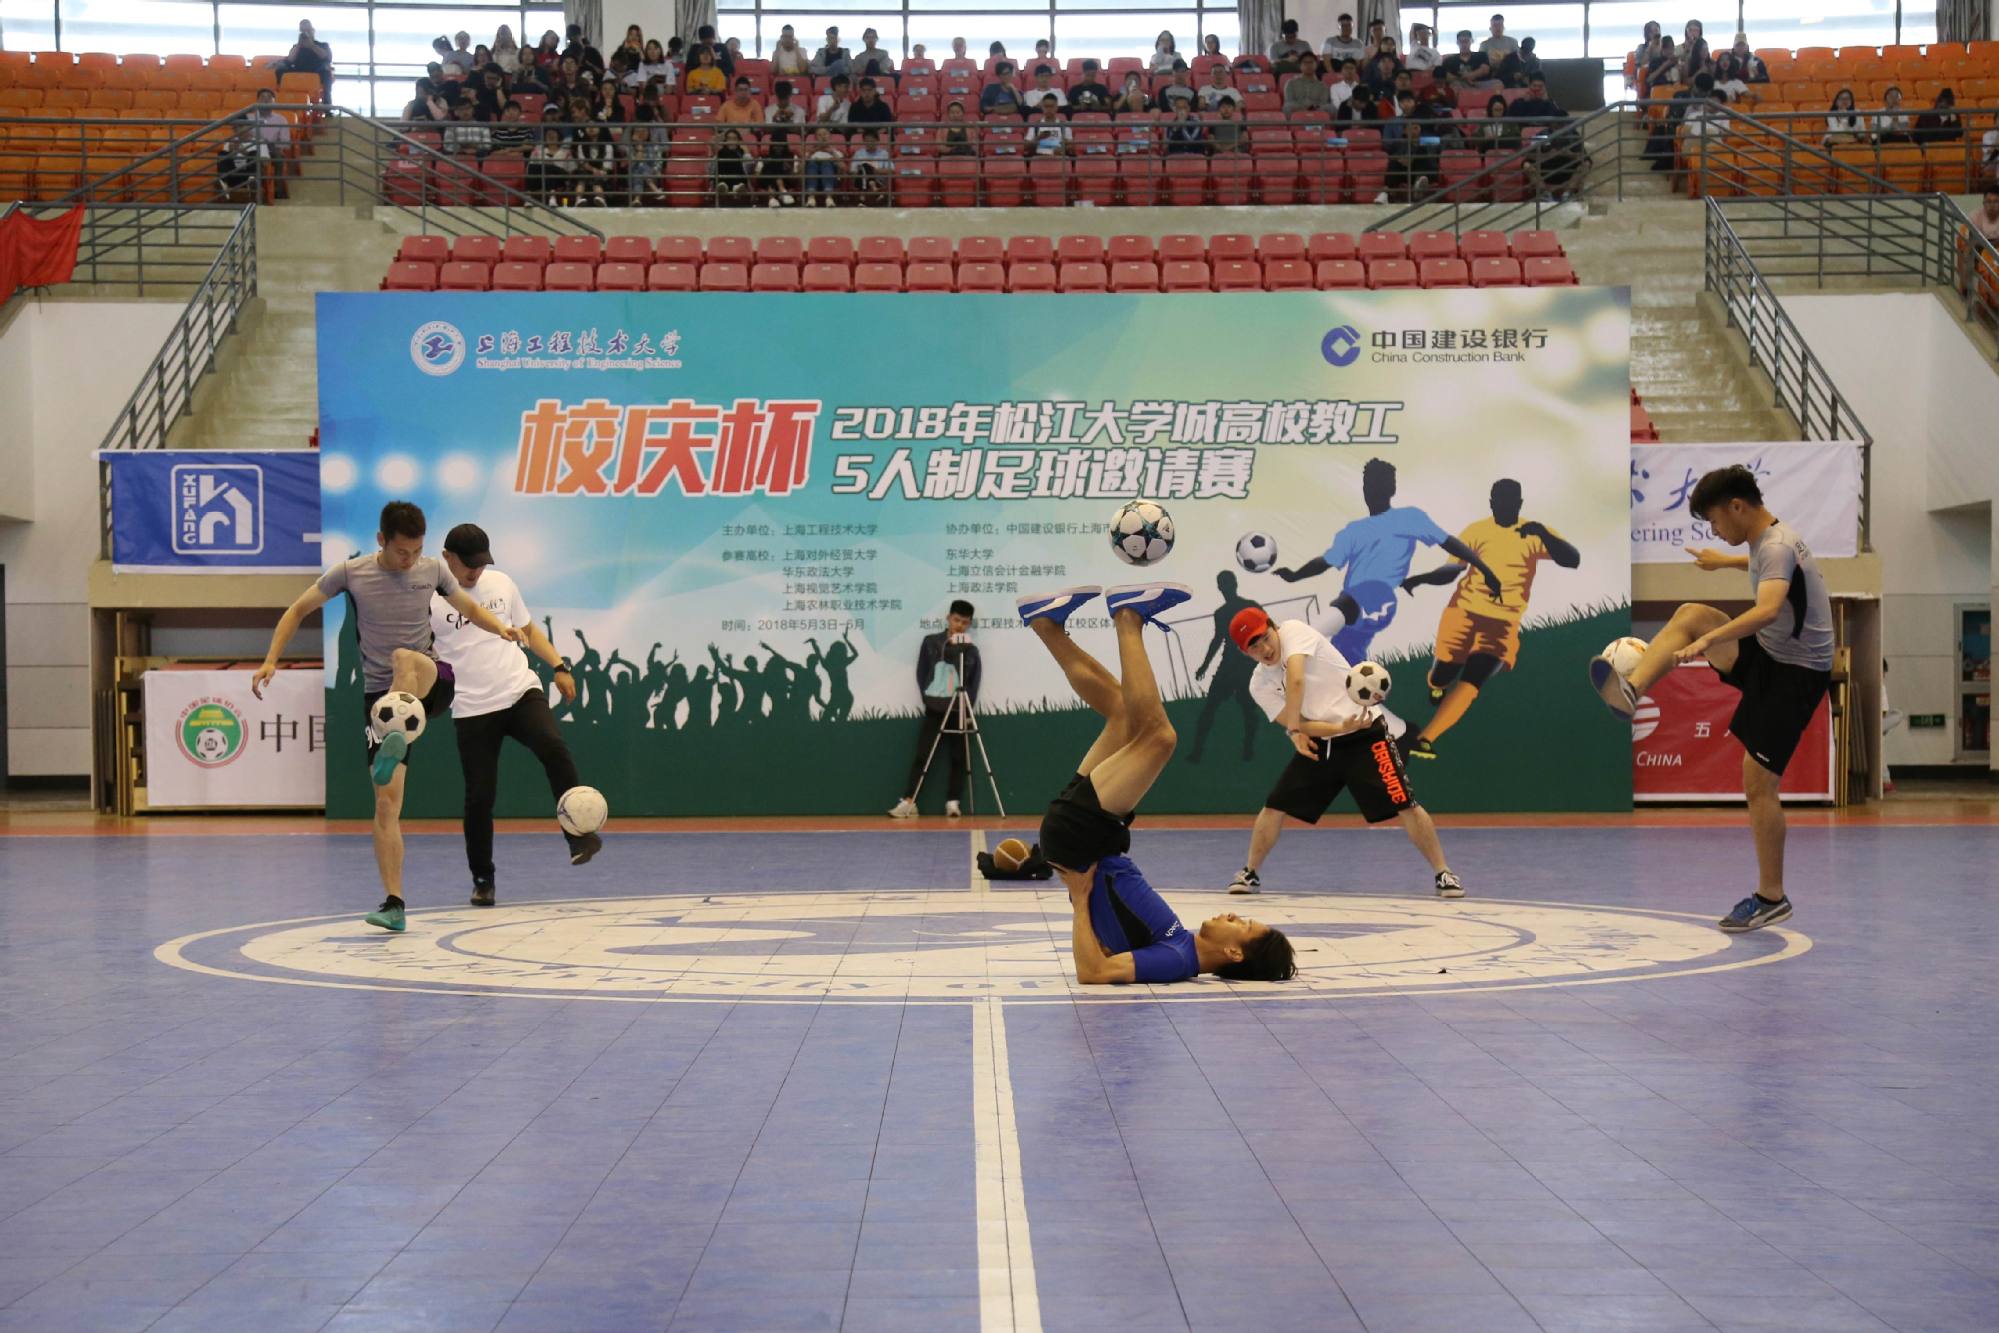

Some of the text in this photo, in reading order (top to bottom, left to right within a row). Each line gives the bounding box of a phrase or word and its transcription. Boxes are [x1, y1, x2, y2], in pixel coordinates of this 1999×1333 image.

[477, 328, 682, 356] 上海工程技术大学
[1371, 328, 1549, 350] 中国建设银行
[1371, 351, 1526, 363] China Construction Bank
[477, 358, 682, 370] Shanghai University of Engineering Science
[830, 400, 1404, 445] 2018年松江大学城高校教工
[514, 399, 822, 496] 校庆杯
[830, 447, 1256, 500] 5人制足球邀请赛
[945, 549, 994, 560] 东华大学
[783, 566, 854, 578] 华东政法大学
[945, 565, 1066, 577] 上海立信会计金融学院
[782, 582, 878, 594] 上海视觉艺术学院
[945, 581, 1018, 593] 上海政法学院
[782, 599, 902, 611] 上海农林职业技术学院
[1636, 751, 1683, 767] CHINA
